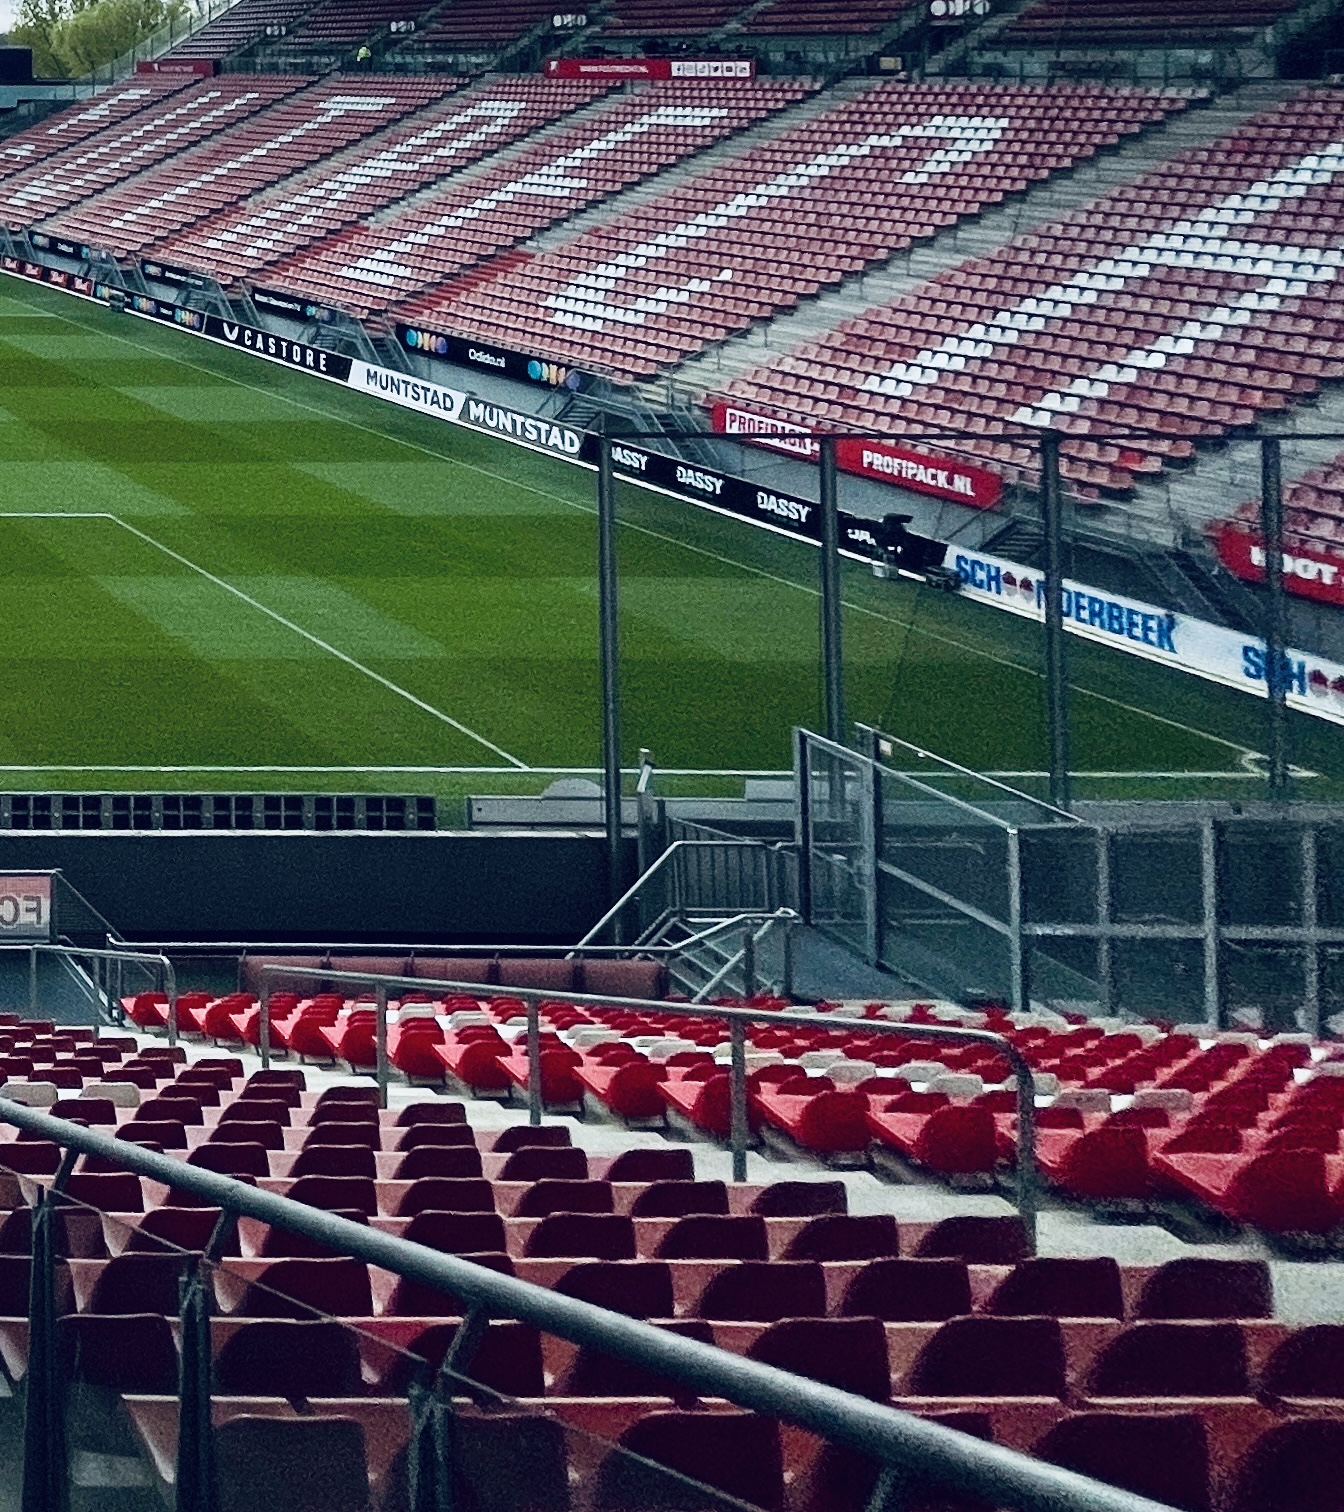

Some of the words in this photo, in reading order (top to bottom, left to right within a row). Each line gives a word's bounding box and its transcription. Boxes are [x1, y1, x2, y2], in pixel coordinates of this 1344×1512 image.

[244, 331, 327, 371] CASTORE
[468, 349, 505, 368] Odido.nl
[366, 369, 454, 413] MUNTSTAD
[469, 401, 580, 455] MUNTSTAD
[676, 466, 723, 495] DASSY
[757, 491, 811, 524] DASSY
[862, 451, 975, 497] PROFIPACK.NL
